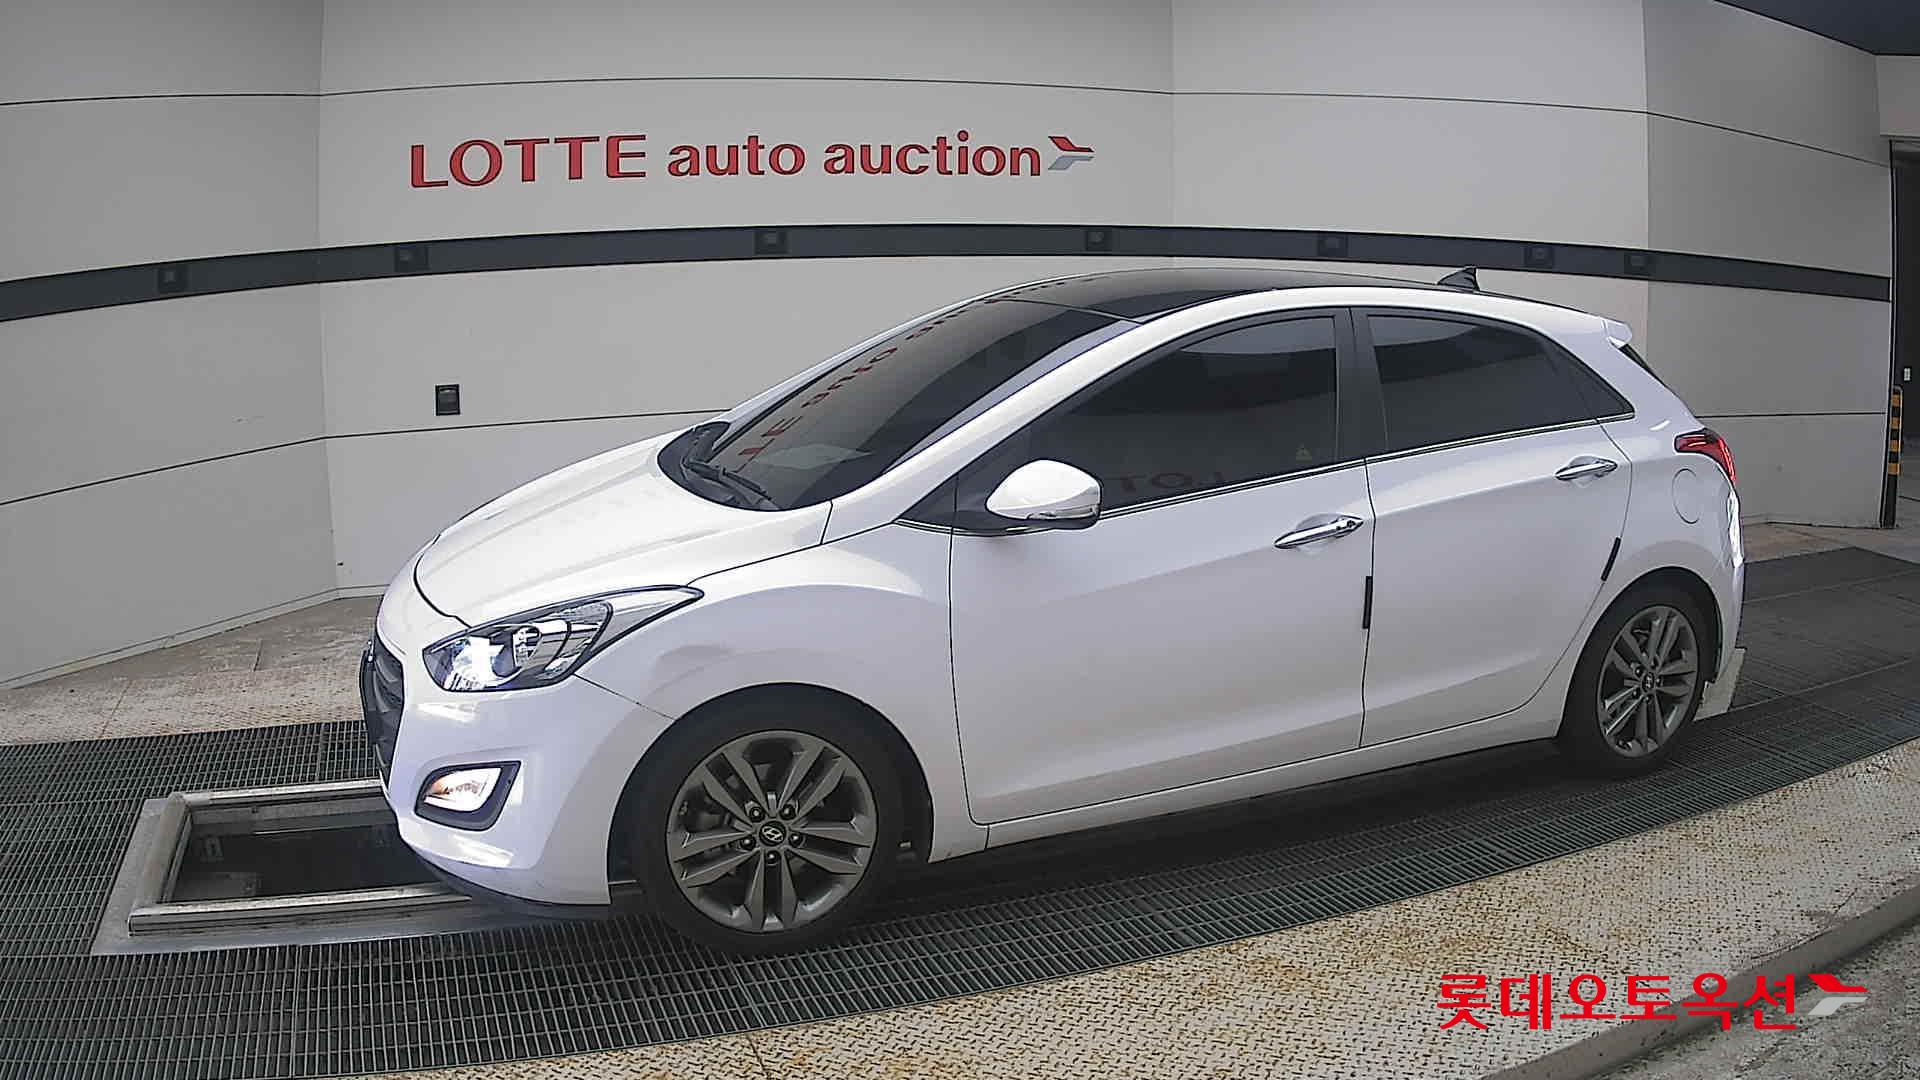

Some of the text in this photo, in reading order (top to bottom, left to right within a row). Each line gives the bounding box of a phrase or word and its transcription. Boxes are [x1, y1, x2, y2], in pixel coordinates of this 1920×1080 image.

[410, 130, 1041, 188] LOTTE auto auction
